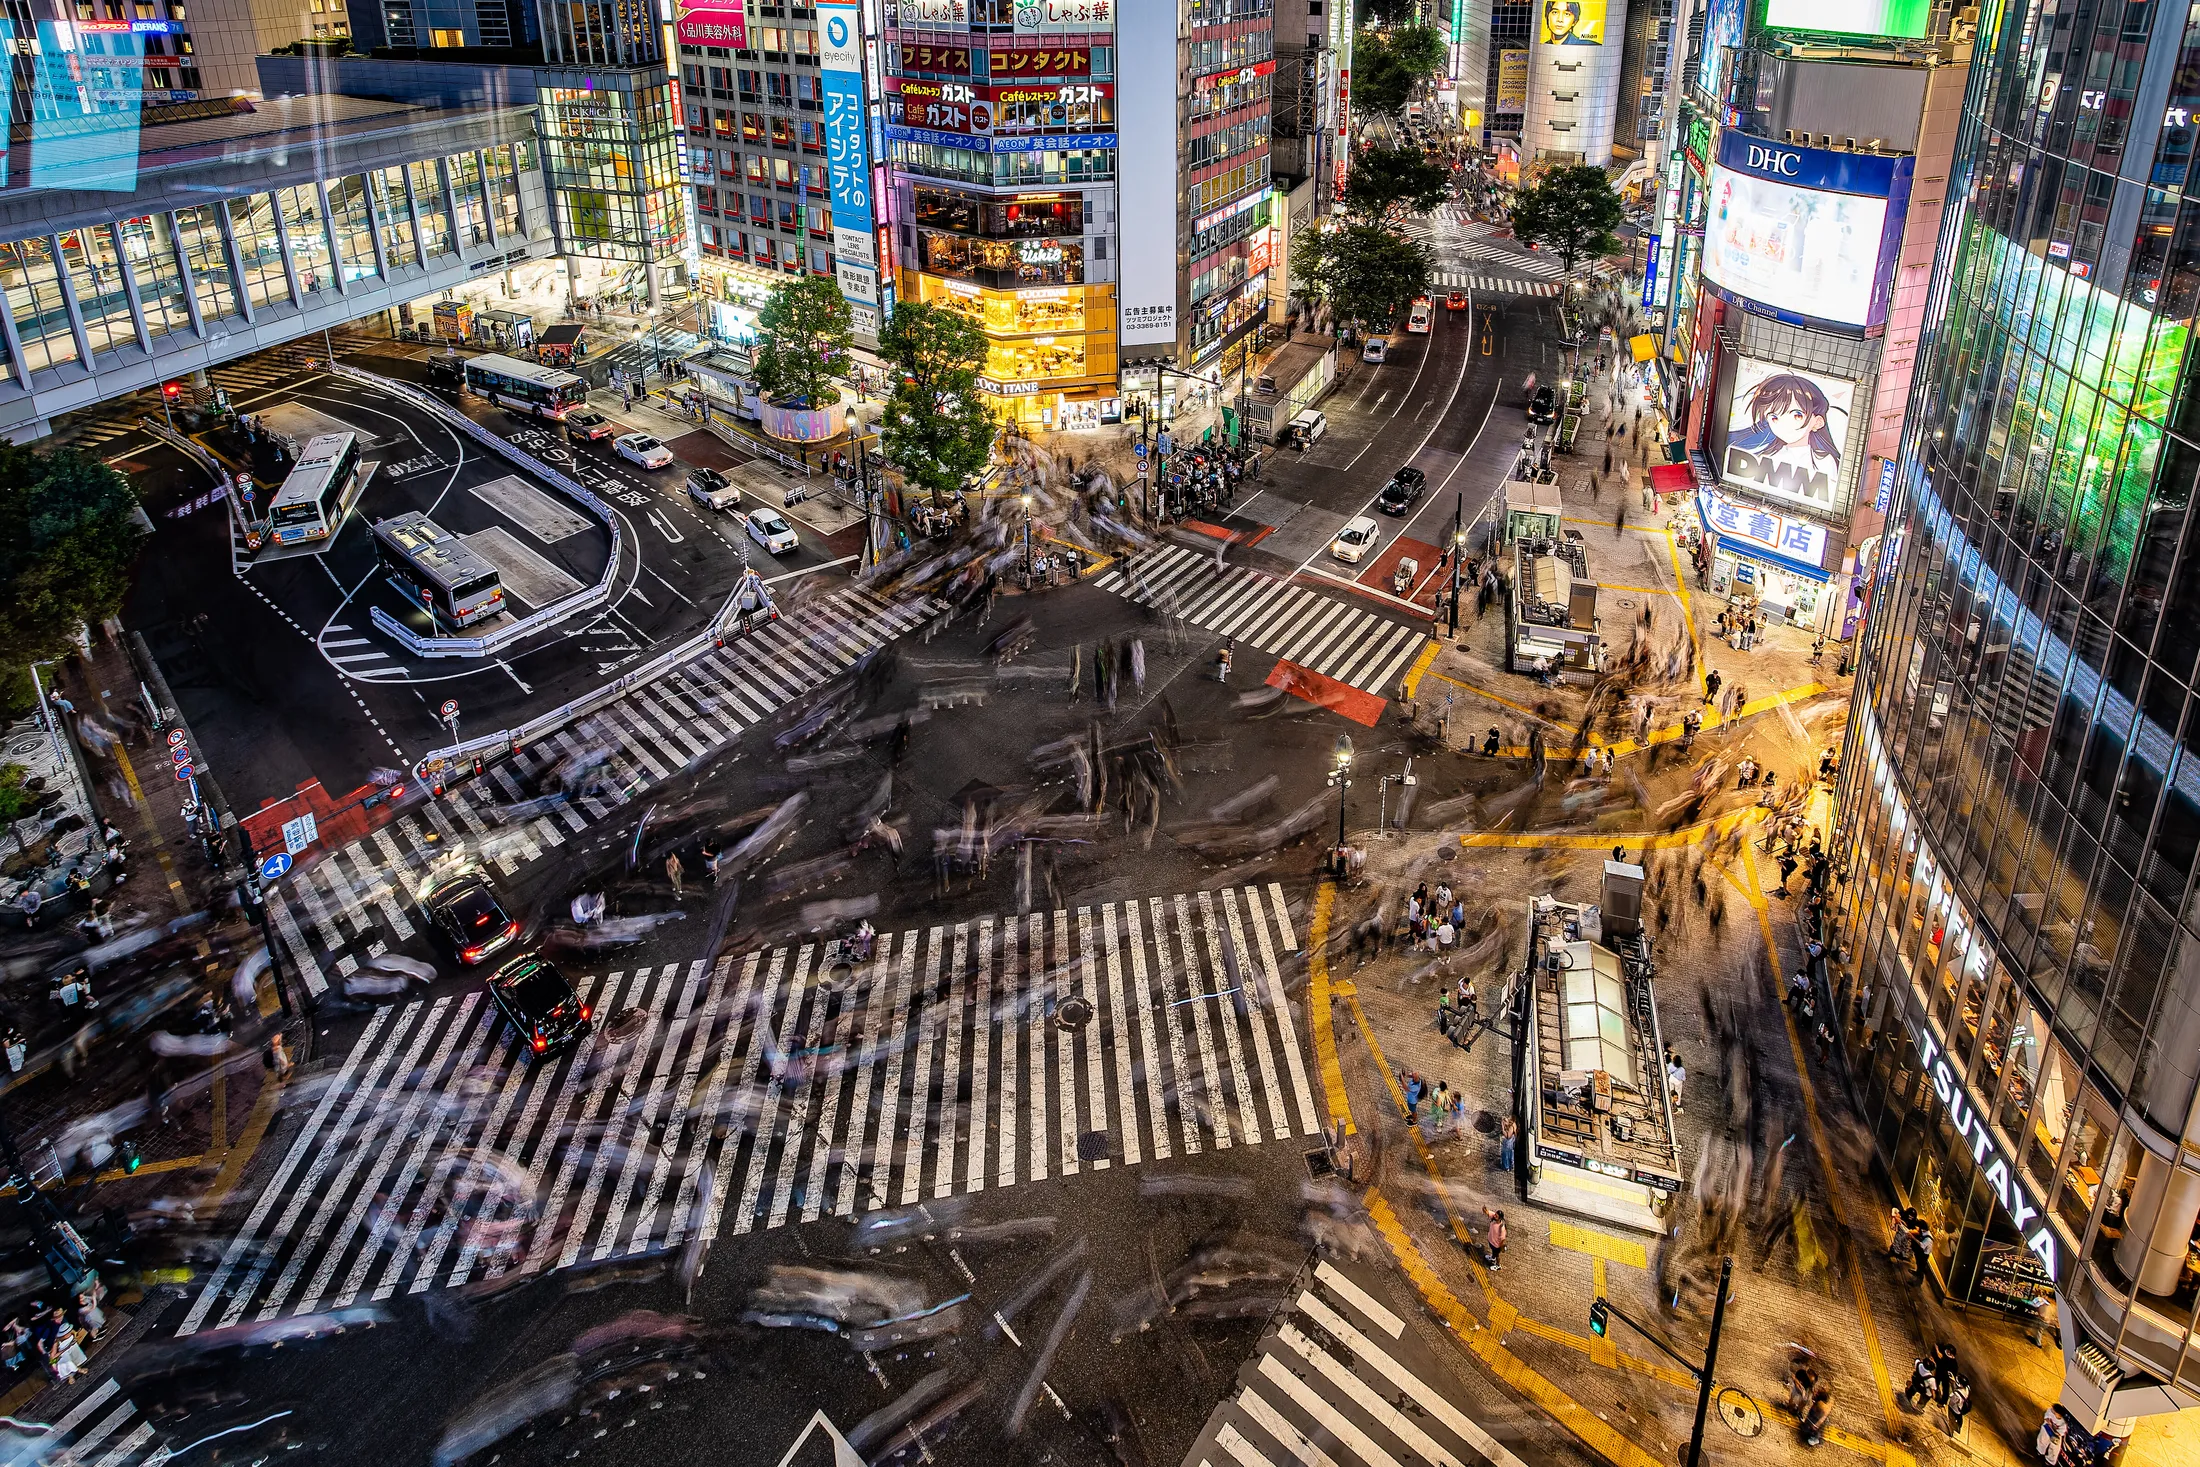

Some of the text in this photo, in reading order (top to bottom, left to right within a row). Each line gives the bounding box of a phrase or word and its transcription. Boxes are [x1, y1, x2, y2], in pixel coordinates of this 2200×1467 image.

[884, 4, 896, 16] 9F
[922, 2, 965, 22] しゃぶ葉
[1048, 1, 1110, 22] しゃぶ葉
[132, 20, 168, 33] ADERANS
[687, 23, 743, 41] 品川美容外科
[824, 51, 856, 65] eyecity
[902, 47, 969, 69] プライス
[991, 51, 1088, 71] コンタクト
[1239, 67, 1257, 84] ガスト
[942, 83, 976, 104] ガスト
[1059, 86, 1105, 104] ガスト
[907, 103, 925, 115] Café
[927, 104, 967, 128] ガスト
[889, 127, 909, 139] AEON
[913, 129, 973, 148] 英会話イーオン
[997, 135, 1116, 151] AEON 英会話イーオン
[827, 92, 850, 204] アイシティ
[846, 94, 866, 208] コンタクトの
[1746, 144, 1801, 176] DHC
[842, 233, 865, 244] CONTACT
[847, 242, 861, 251] LENS
[838, 246, 871, 260] SPECIALISTS
[1019, 247, 1062, 263] Ushi8
[846, 281, 867, 295] 专卖店
[1243, 273, 1266, 299] LUSH
[1125, 305, 1173, 317] 広告主募集中
[1732, 295, 1778, 319] DHC Channel
[1126, 315, 1172, 324] ツツミプロジェクト
[528, 438, 652, 508] 路線バスのみ
[1727, 447, 1830, 504] DMM
[1921, 1027, 2058, 1284] TSUTAYA
[1985, 1296, 2018, 1310] Blu-ray
